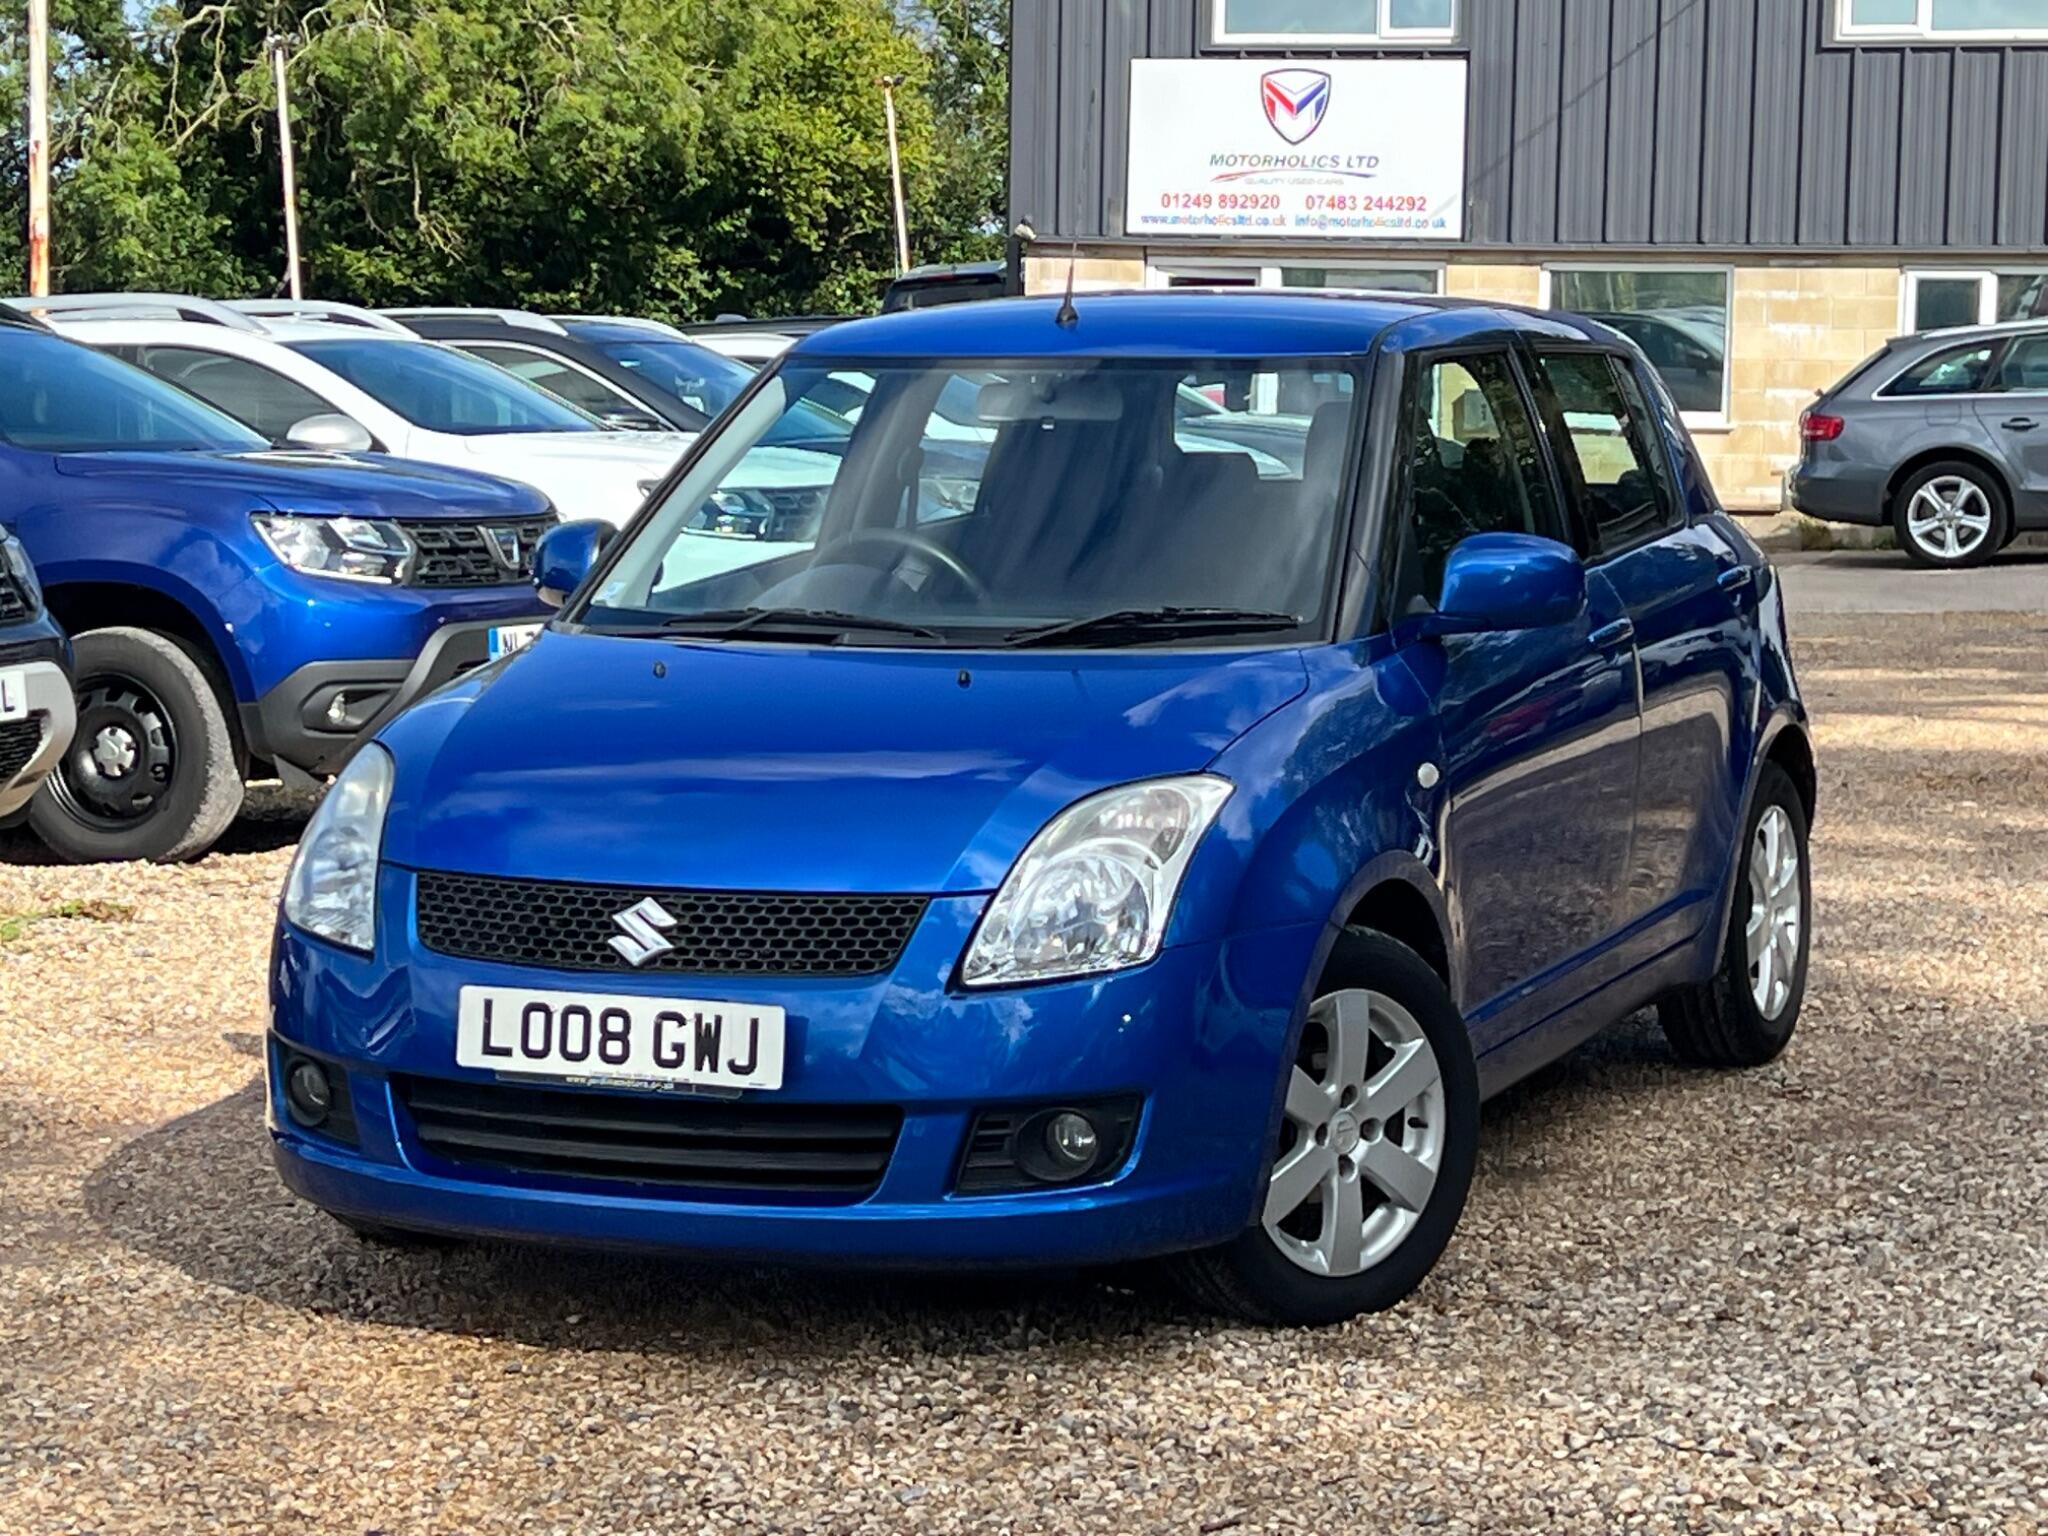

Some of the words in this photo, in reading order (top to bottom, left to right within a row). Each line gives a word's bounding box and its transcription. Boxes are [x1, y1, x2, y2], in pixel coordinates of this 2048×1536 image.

[1209, 153, 1340, 168] MOTORHOLICS
[1346, 155, 1380, 169] LTD
[1161, 193, 1212, 209] 01249
[1218, 194, 1280, 209] 892920
[1305, 195, 1357, 210] 07483
[1363, 196, 1427, 212] 244292
[481, 998, 632, 1065] LO08
[652, 1011, 760, 1075] GWJ
